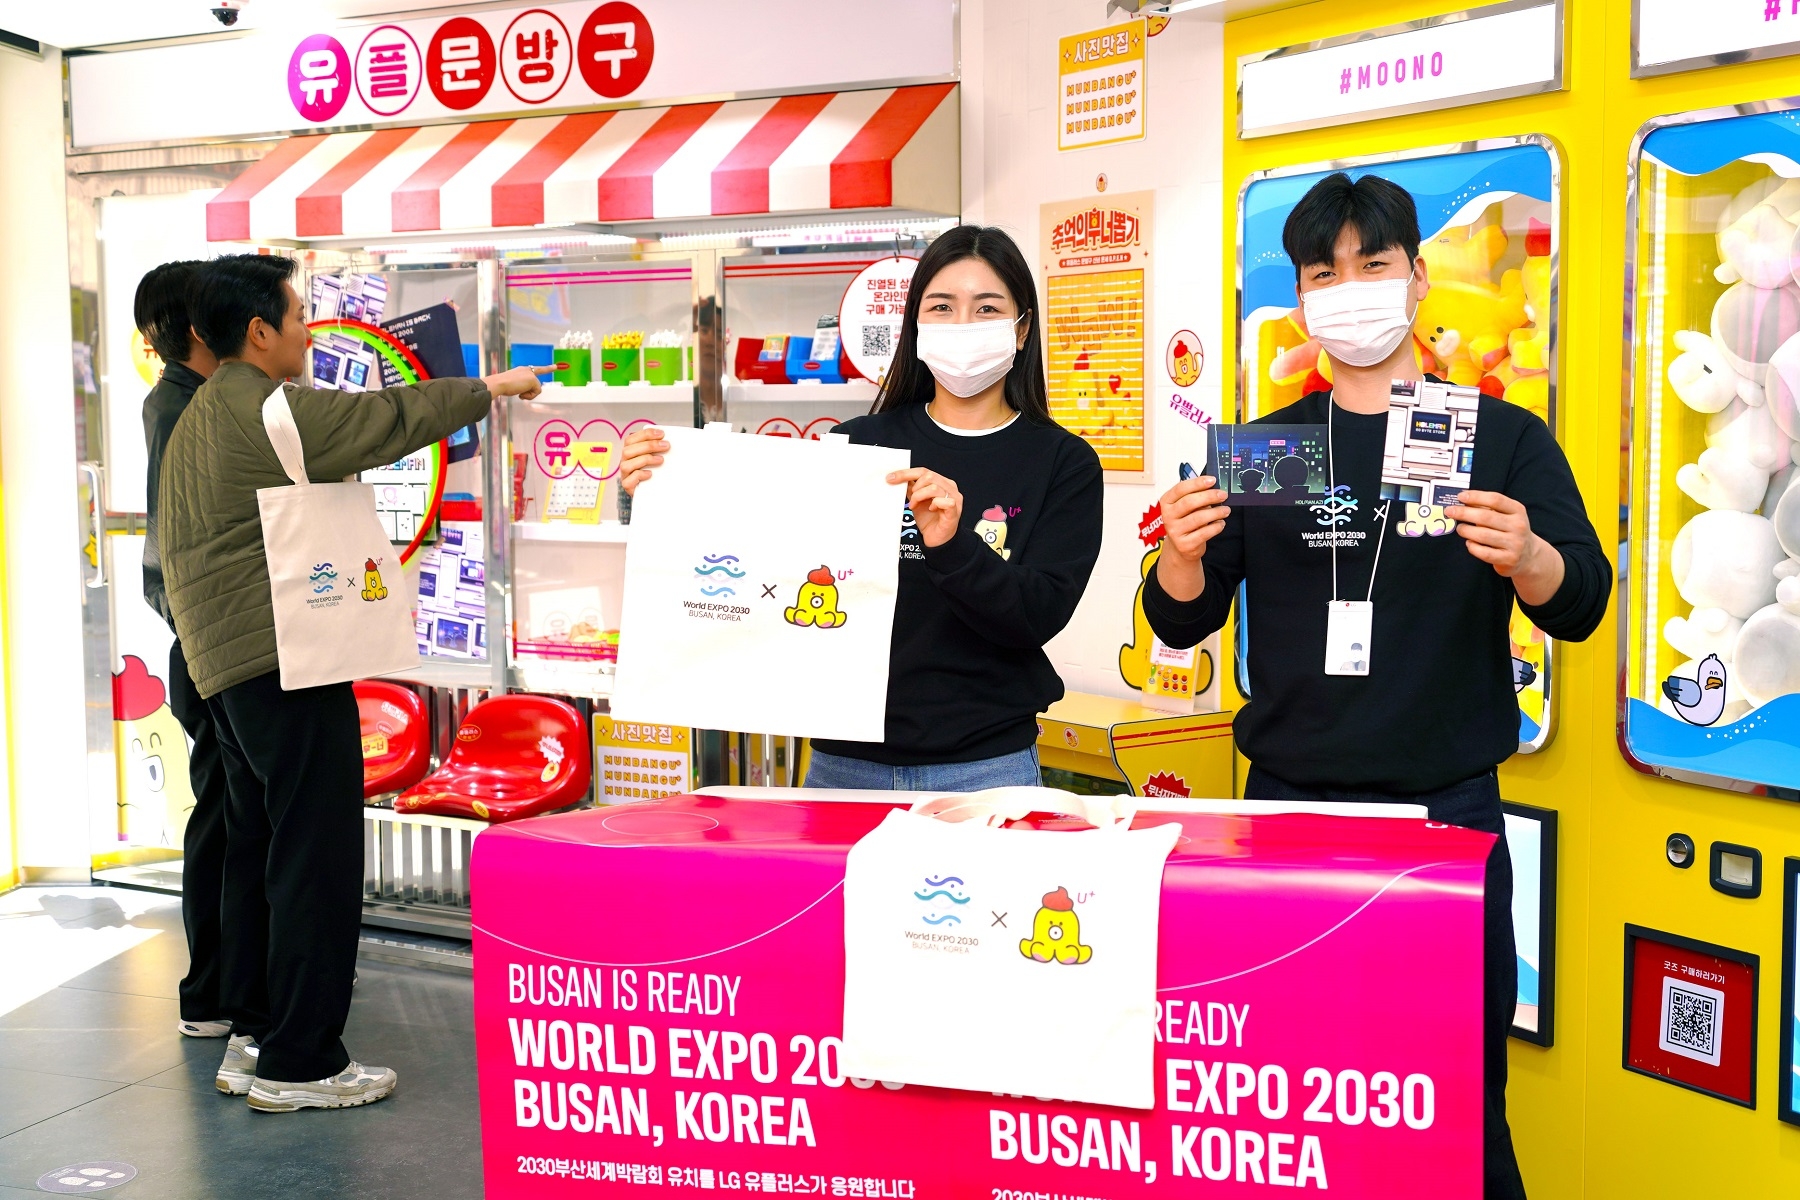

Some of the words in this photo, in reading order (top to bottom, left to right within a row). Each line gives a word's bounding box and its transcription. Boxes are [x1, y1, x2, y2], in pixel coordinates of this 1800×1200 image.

[1073, 31, 1129, 64] 사진맛집
[1340, 51, 1443, 94] #MOONO
[867, 279, 896, 290] 진열된
[866, 304, 885, 314] 구매
[1301, 532, 1324, 540] World
[1346, 531, 1366, 539] 2030
[683, 601, 706, 610] World
[707, 603, 729, 613] EXPO
[730, 605, 750, 614] 2030
[717, 613, 741, 622] KOREA
[611, 723, 672, 745] 사진맛집
[904, 931, 930, 941] World
[932, 933, 955, 944] EXPO
[957, 936, 979, 946] 2030
[943, 946, 970, 954] KOREA
[1663, 960, 1678, 971] 굿즈
[508, 963, 602, 1009] BUSAN
[613, 969, 638, 1011] IS
[648, 970, 742, 1017] READY
[508, 1017, 657, 1075] WORLD
[668, 1028, 778, 1084] EXPO
[789, 1034, 906, 1091] 20
[1166, 1058, 1289, 1121] EXPO
[1303, 1066, 1436, 1131] 2030
[513, 1079, 665, 1148] BUSAN,
[675, 1090, 817, 1148] KOREA
[989, 1108, 1158, 1184] BUSAN,
[1171, 1124, 1329, 1190] KOREA
[516, 1156, 663, 1186] 2030부산세계박람회
[667, 1167, 715, 1190] 유치를
[719, 1171, 741, 1188] LG
[744, 1172, 827, 1196] 유플러스가
[831, 1176, 916, 1200] 응원합니다
